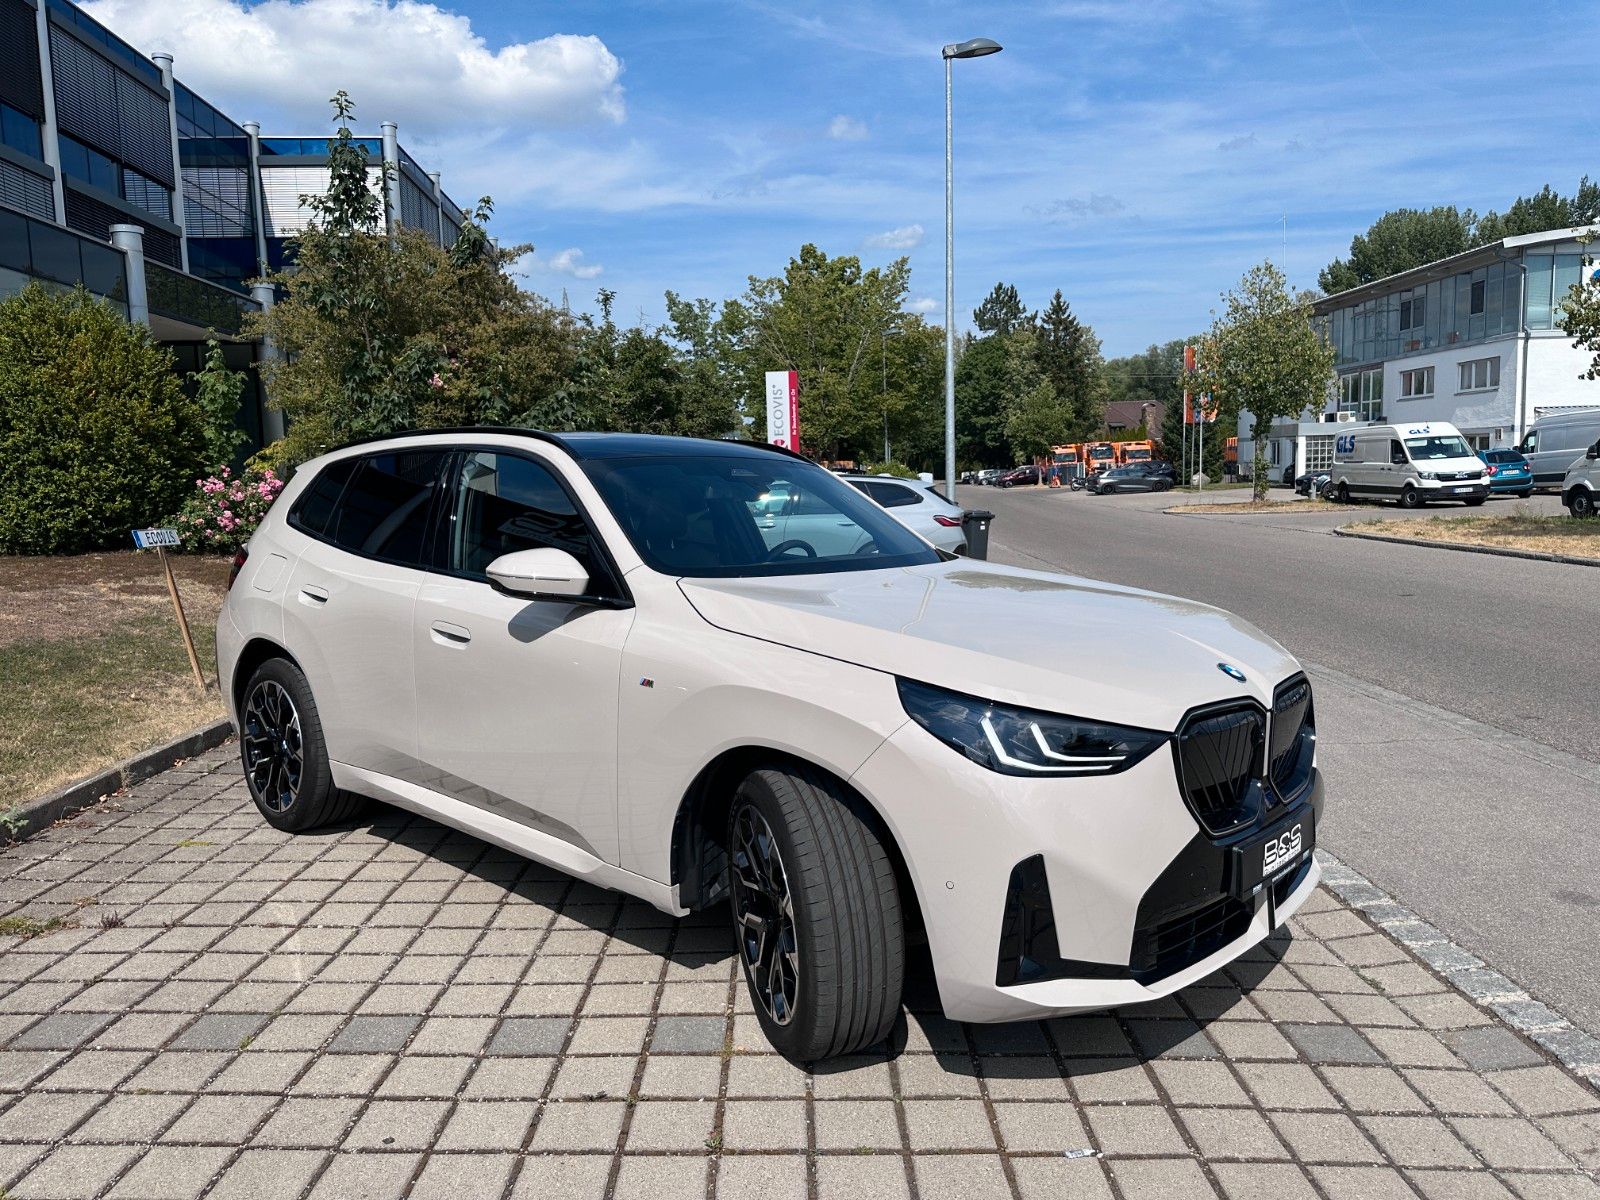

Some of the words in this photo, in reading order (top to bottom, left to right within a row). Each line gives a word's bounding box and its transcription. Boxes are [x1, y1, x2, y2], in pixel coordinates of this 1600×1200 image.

[772, 388, 785, 436] ECOVIS
[1336, 434, 1356, 453] GLS
[144, 530, 177, 545] ECOVIS
[1264, 823, 1302, 867] B&S
